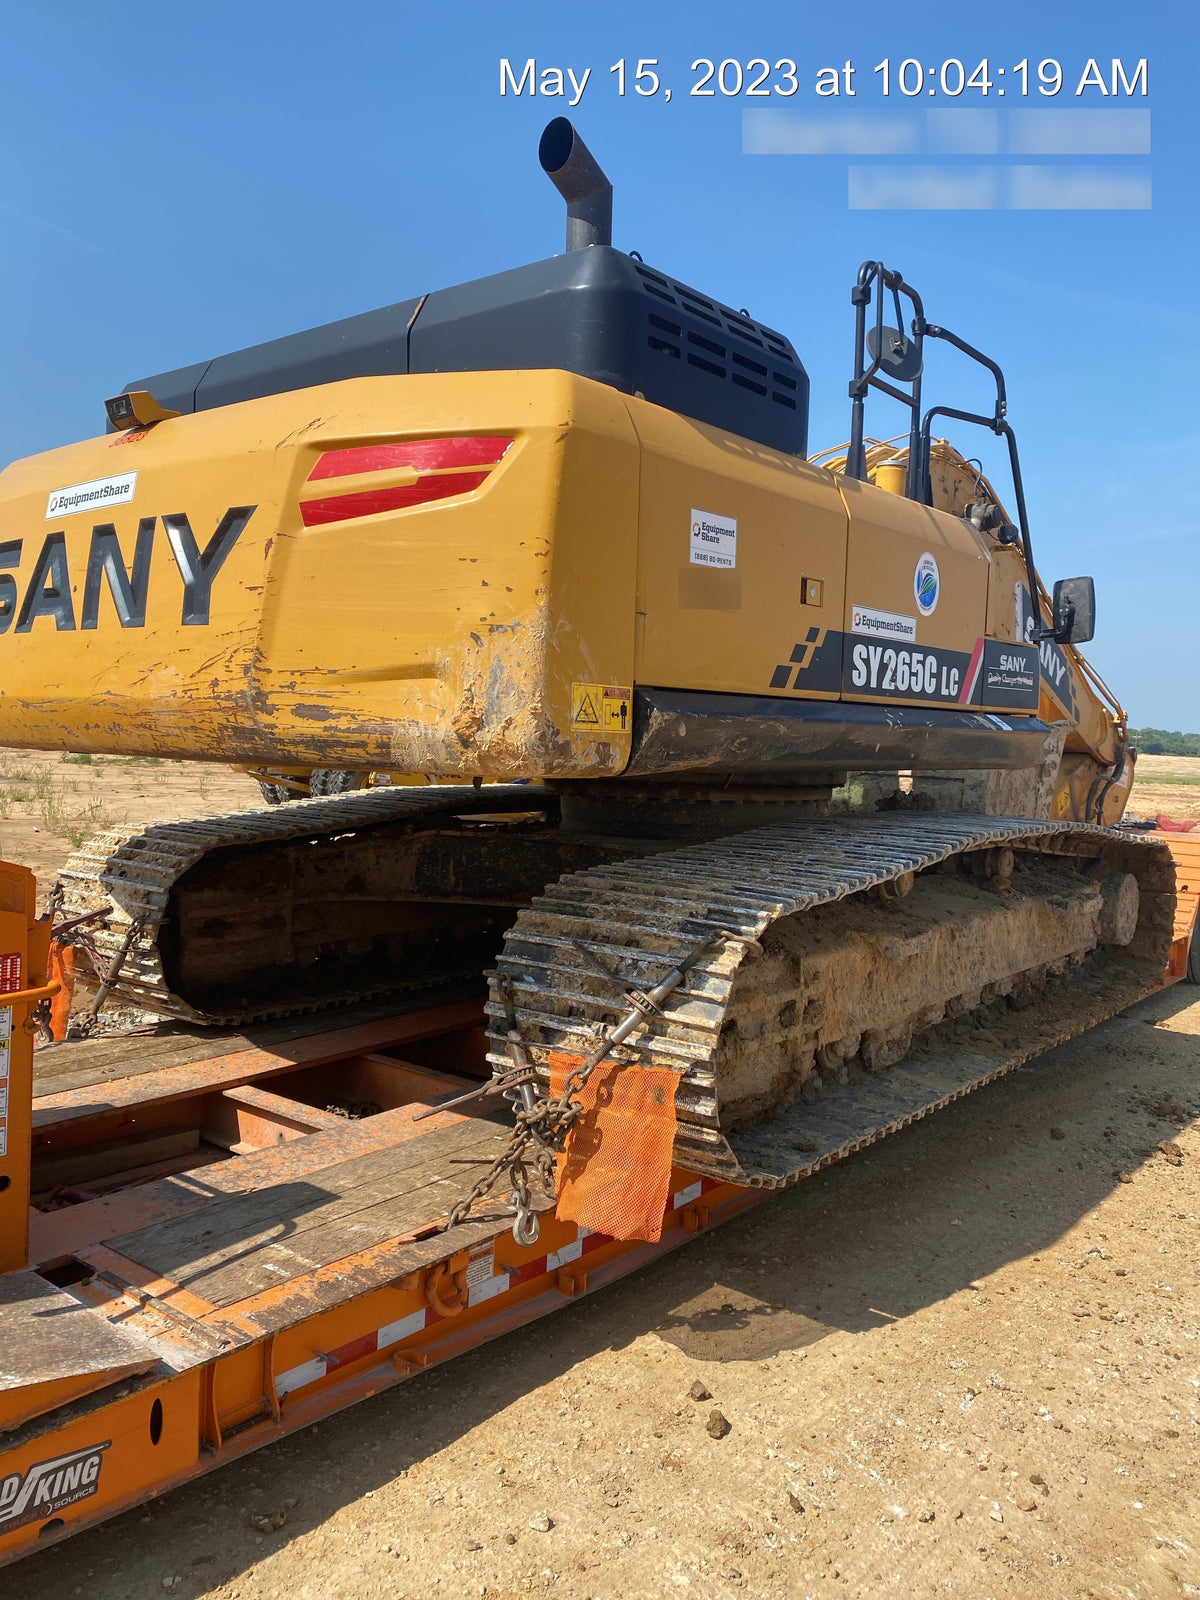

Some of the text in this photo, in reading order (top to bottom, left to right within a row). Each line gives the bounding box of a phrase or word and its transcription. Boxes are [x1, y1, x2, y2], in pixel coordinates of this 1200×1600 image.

[58, 484, 130, 508] EquipmentShare
[701, 532, 720, 543] Share
[702, 522, 735, 537] Equipment
[862, 615, 914, 634] EquipmentShare
[852, 644, 959, 696] SY265C LC
[1000, 655, 1026, 673] SANY
[33, 1455, 100, 1507] KING
[54, 1485, 96, 1509] SOURCE
